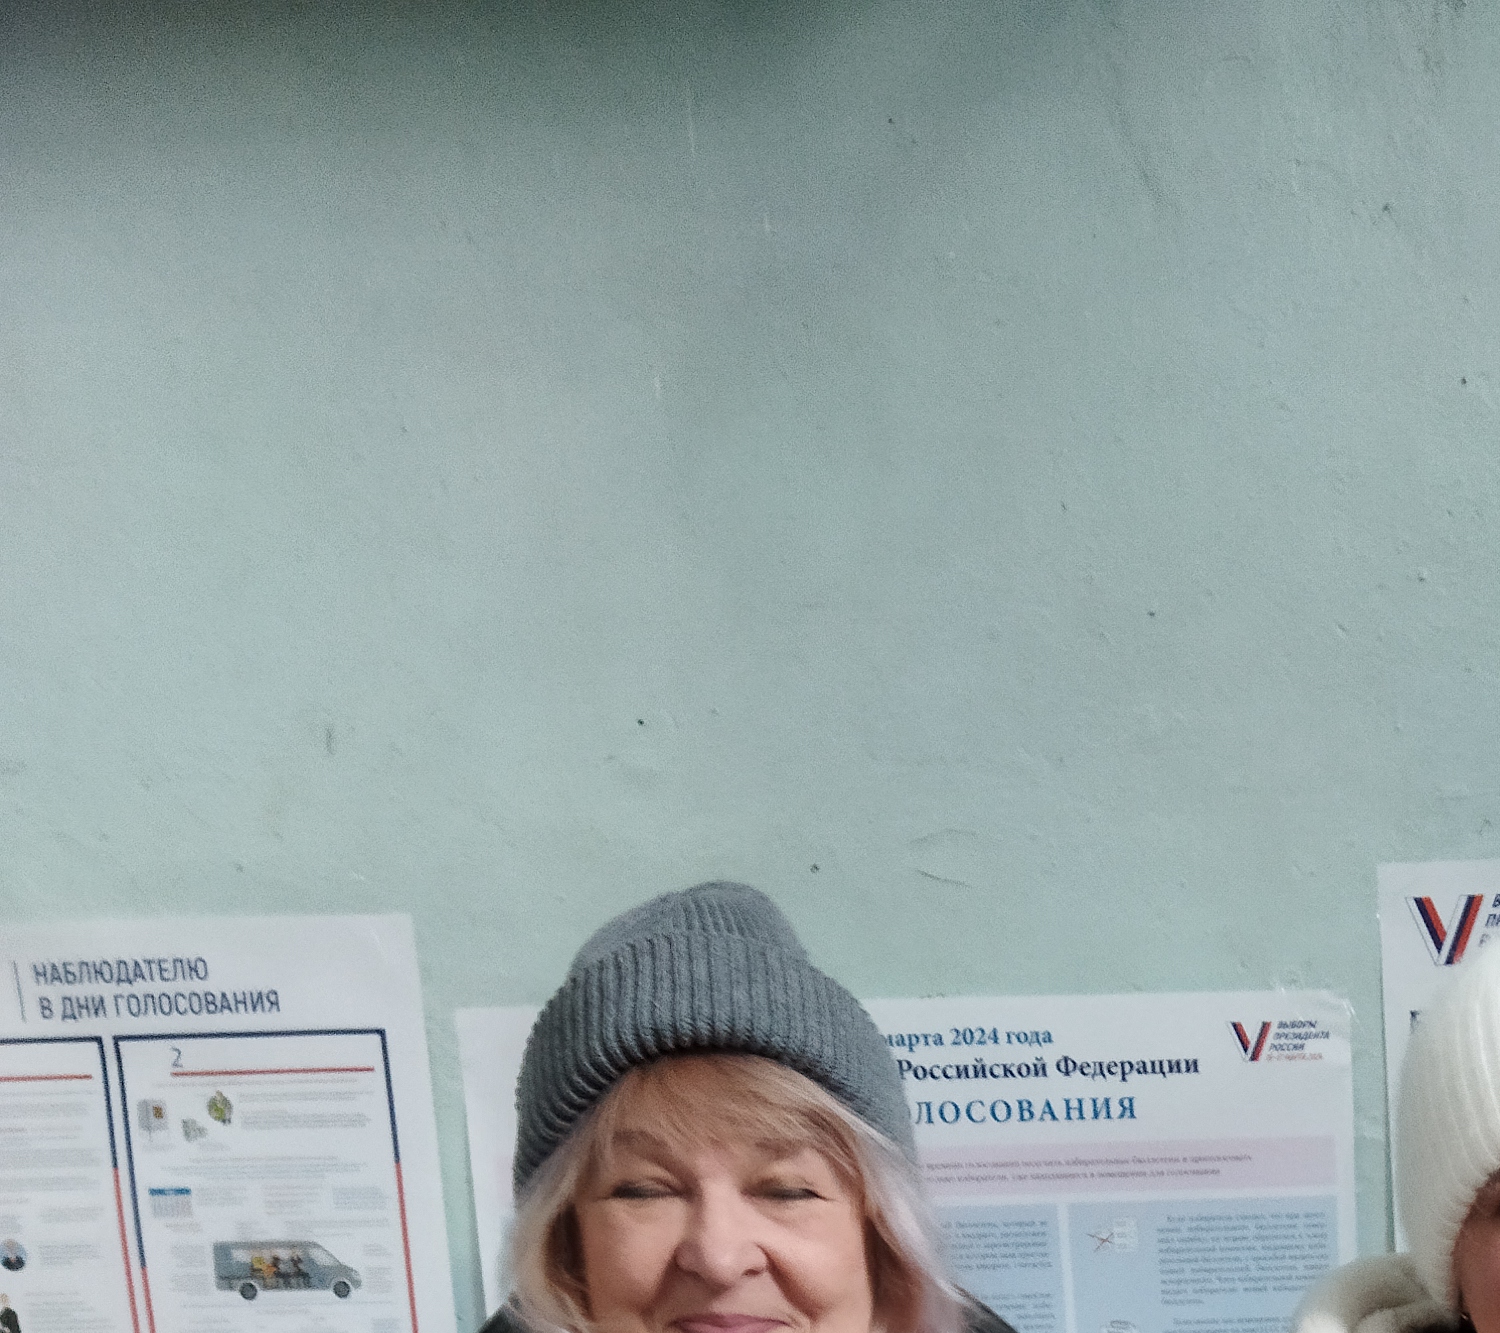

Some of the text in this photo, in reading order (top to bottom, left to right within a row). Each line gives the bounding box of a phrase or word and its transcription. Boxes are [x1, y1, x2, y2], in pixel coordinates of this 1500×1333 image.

[33, 957, 208, 986] НАБЛЮДАТЕЛЮ
[39, 989, 281, 1023] В ДНИ ГОЛОСОВАНИЯ
[949, 1027, 1000, 1047] 2024
[1005, 1028, 1054, 1048] года
[170, 1046, 184, 1069] 2
[896, 1053, 1200, 1083] Российской Федерации
[914, 1096, 1138, 1125] ЛОСОВАНИЯ
